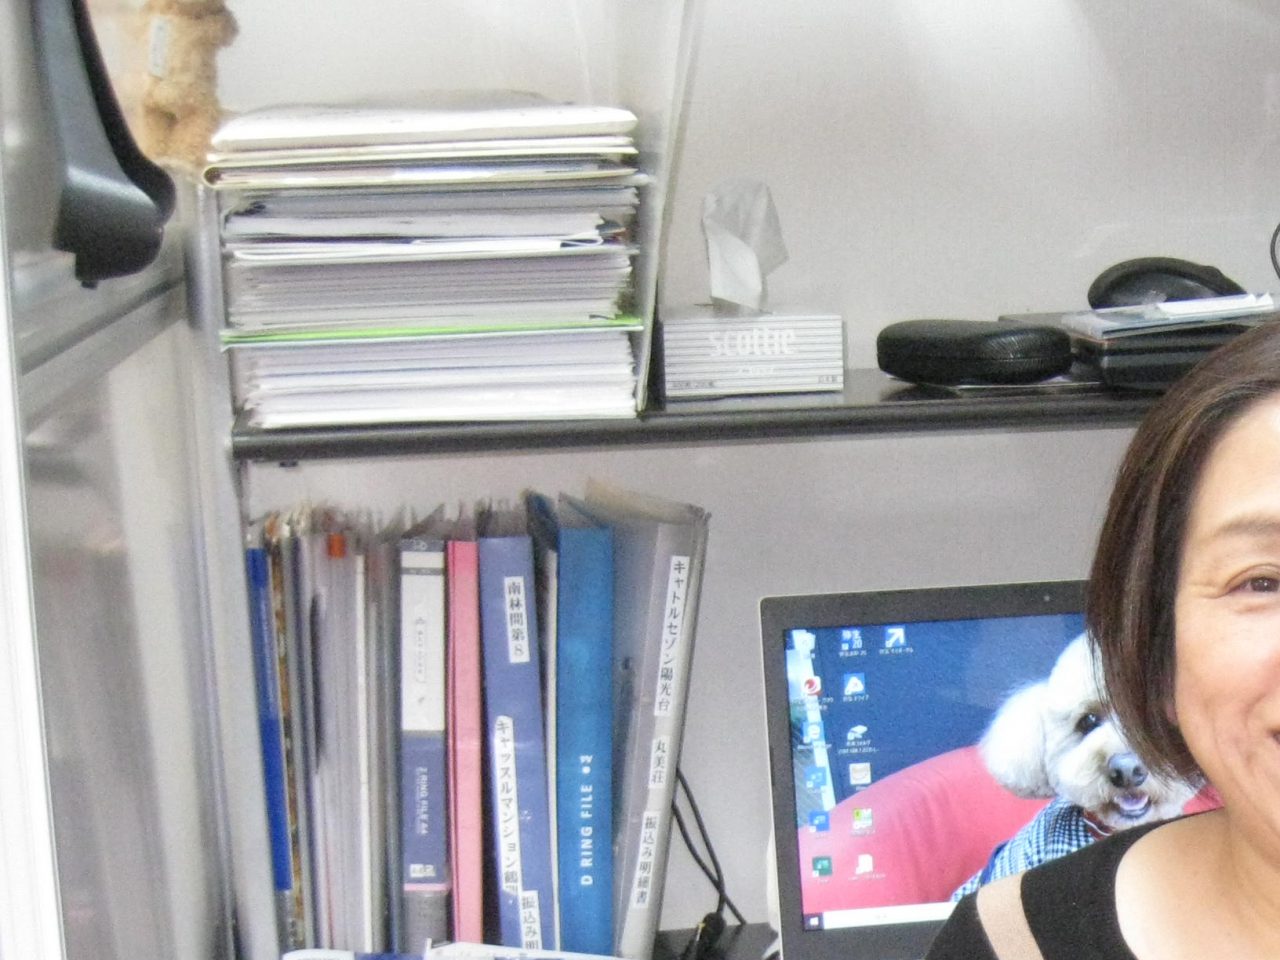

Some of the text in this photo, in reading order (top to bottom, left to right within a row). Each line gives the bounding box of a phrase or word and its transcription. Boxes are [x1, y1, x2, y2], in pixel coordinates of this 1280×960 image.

[580, 784, 593, 886] D RING FILE
